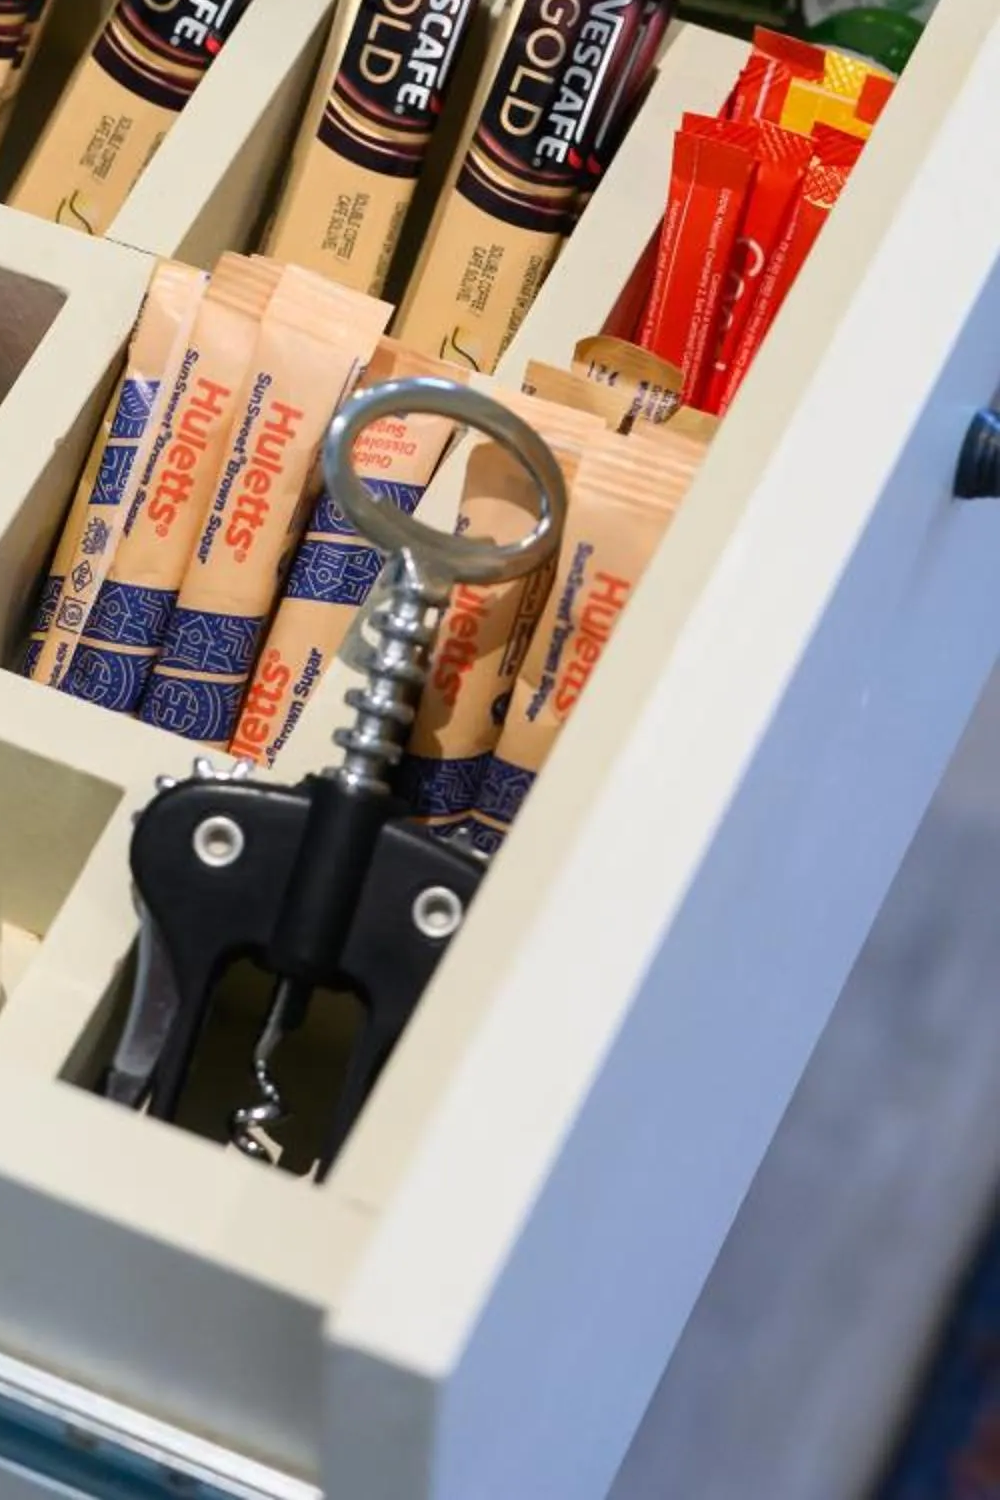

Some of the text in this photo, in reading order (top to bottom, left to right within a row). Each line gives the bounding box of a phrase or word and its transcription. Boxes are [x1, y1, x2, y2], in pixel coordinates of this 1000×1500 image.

[148, 377, 231, 526] Huletts
[225, 402, 304, 551] Huletts
[231, 660, 290, 760] letts
[273, 647, 323, 751] Brown Sugar
